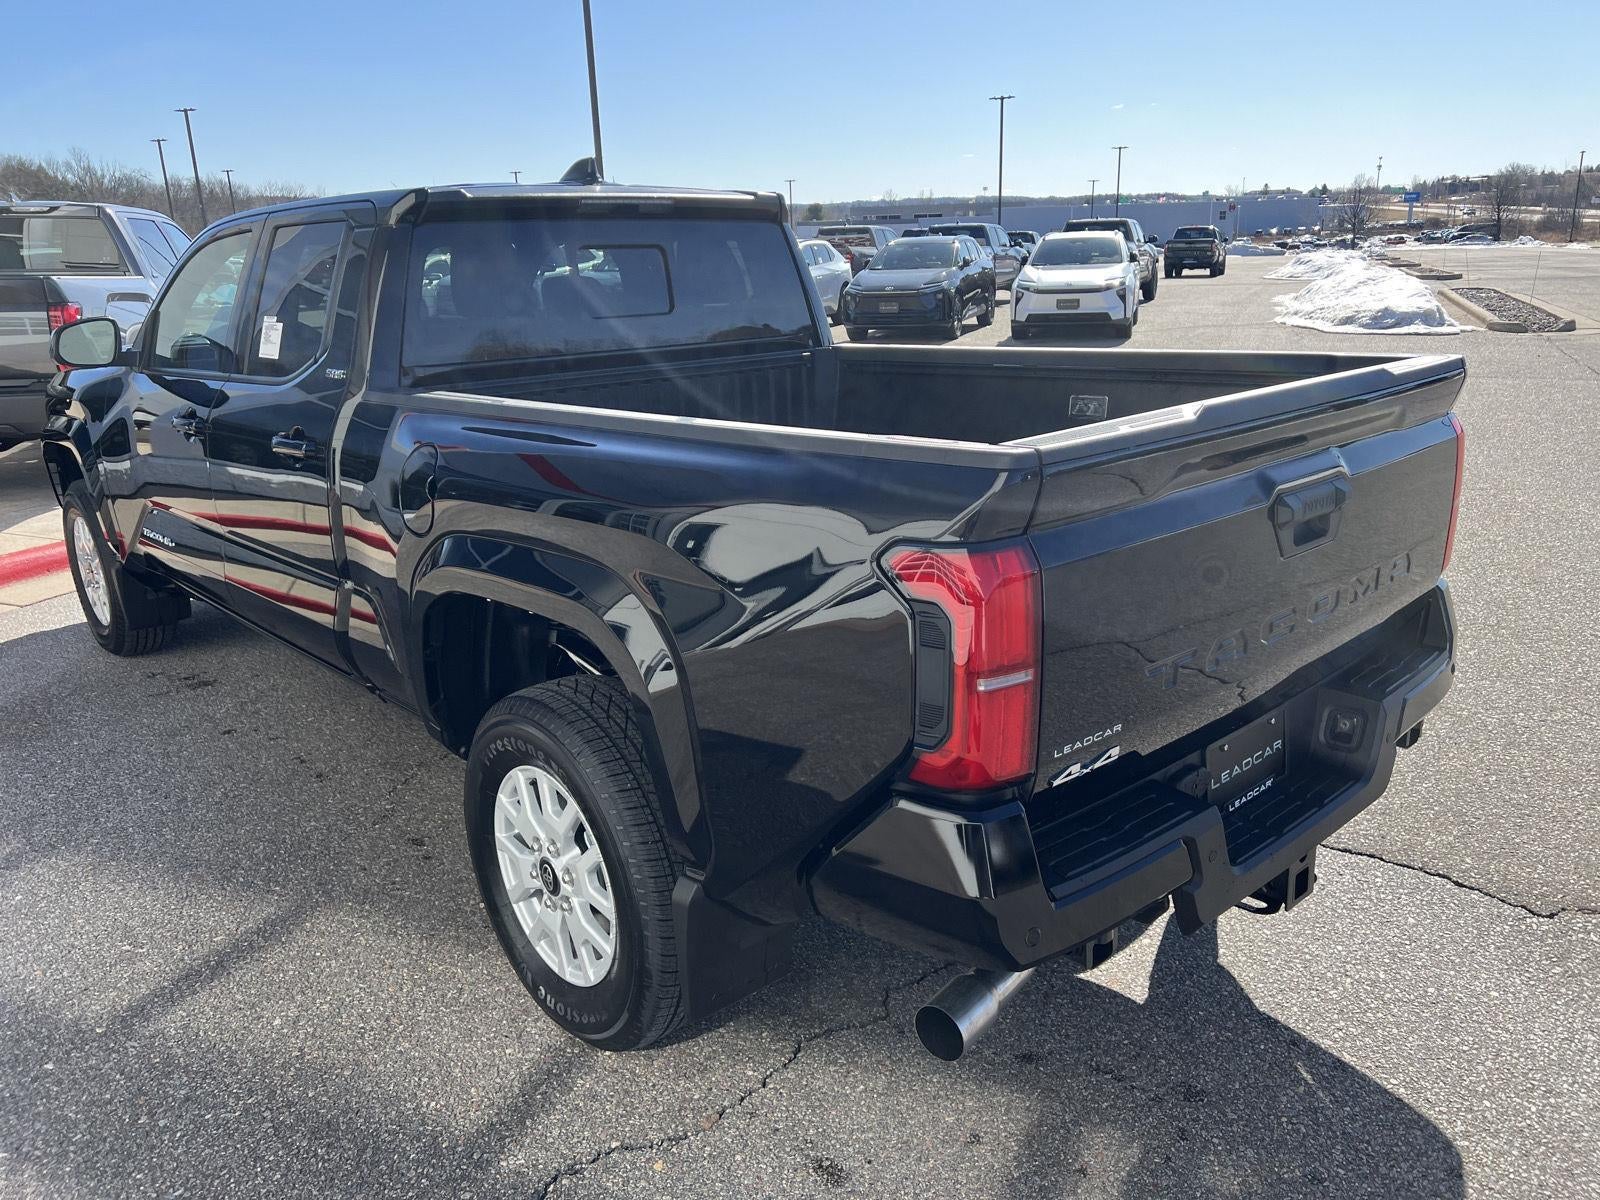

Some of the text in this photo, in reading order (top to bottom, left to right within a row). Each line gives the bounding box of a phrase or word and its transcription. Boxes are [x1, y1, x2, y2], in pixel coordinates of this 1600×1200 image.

[1145, 552, 1419, 689] TACOMA
[1054, 723, 1122, 758] LEADCAR
[1050, 745, 1120, 788] 4x4
[1211, 739, 1282, 790] LEADCAR
[1228, 777, 1273, 812] LEADCAR
